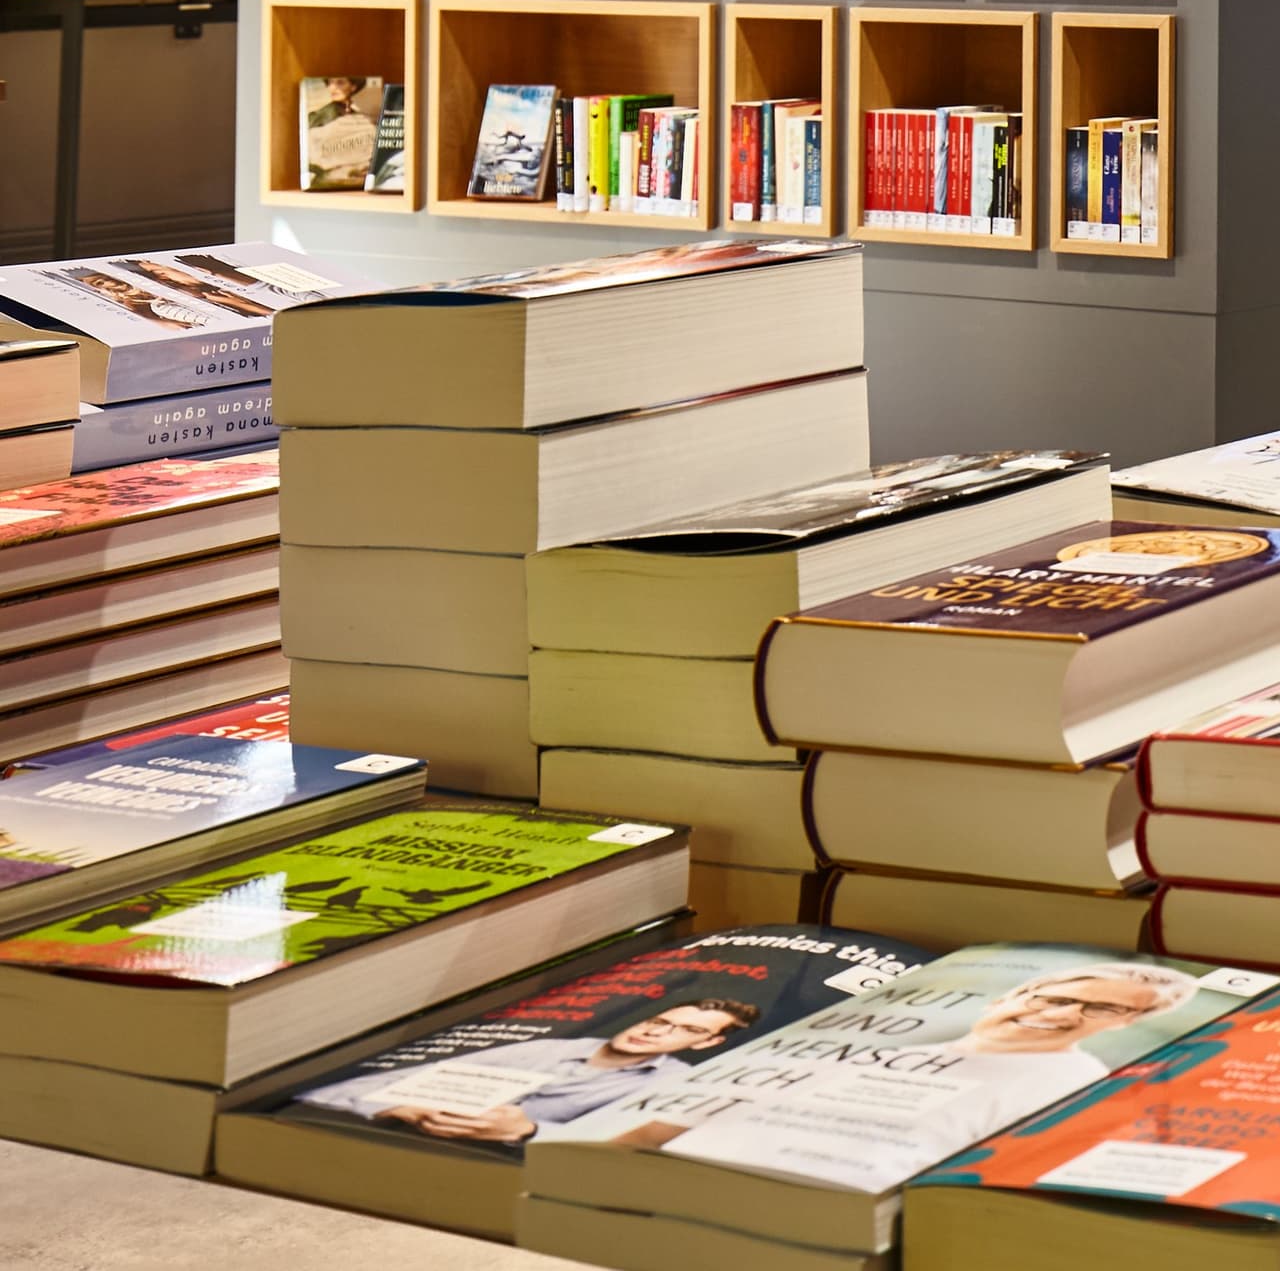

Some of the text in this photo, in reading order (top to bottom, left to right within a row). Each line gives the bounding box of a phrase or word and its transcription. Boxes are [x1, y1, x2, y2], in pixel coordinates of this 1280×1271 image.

[201, 339, 251, 358] again
[195, 356, 259, 376] kasten
[153, 399, 273, 427] dream again
[148, 417, 274, 445] mona kasten
[937, 576, 1149, 600] SPIEGEL
[950, 564, 1220, 589] HILARY MANTEL
[866, 585, 1169, 612] UND LICHT
[942, 604, 1023, 617] ROMAN
[620, 829, 645, 839] C
[369, 834, 535, 860] MISSION
[287, 844, 547, 878] BLINDGÄNGER
[836, 945, 923, 977] thiel
[859, 977, 884, 990] C
[1226, 976, 1252, 989] C
[860, 987, 989, 1011] MUT
[810, 1011, 926, 1035] UND
[745, 1037, 966, 1075] MENSCH
[687, 1065, 814, 1090] LICH
[618, 1092, 755, 1118] KEIT
